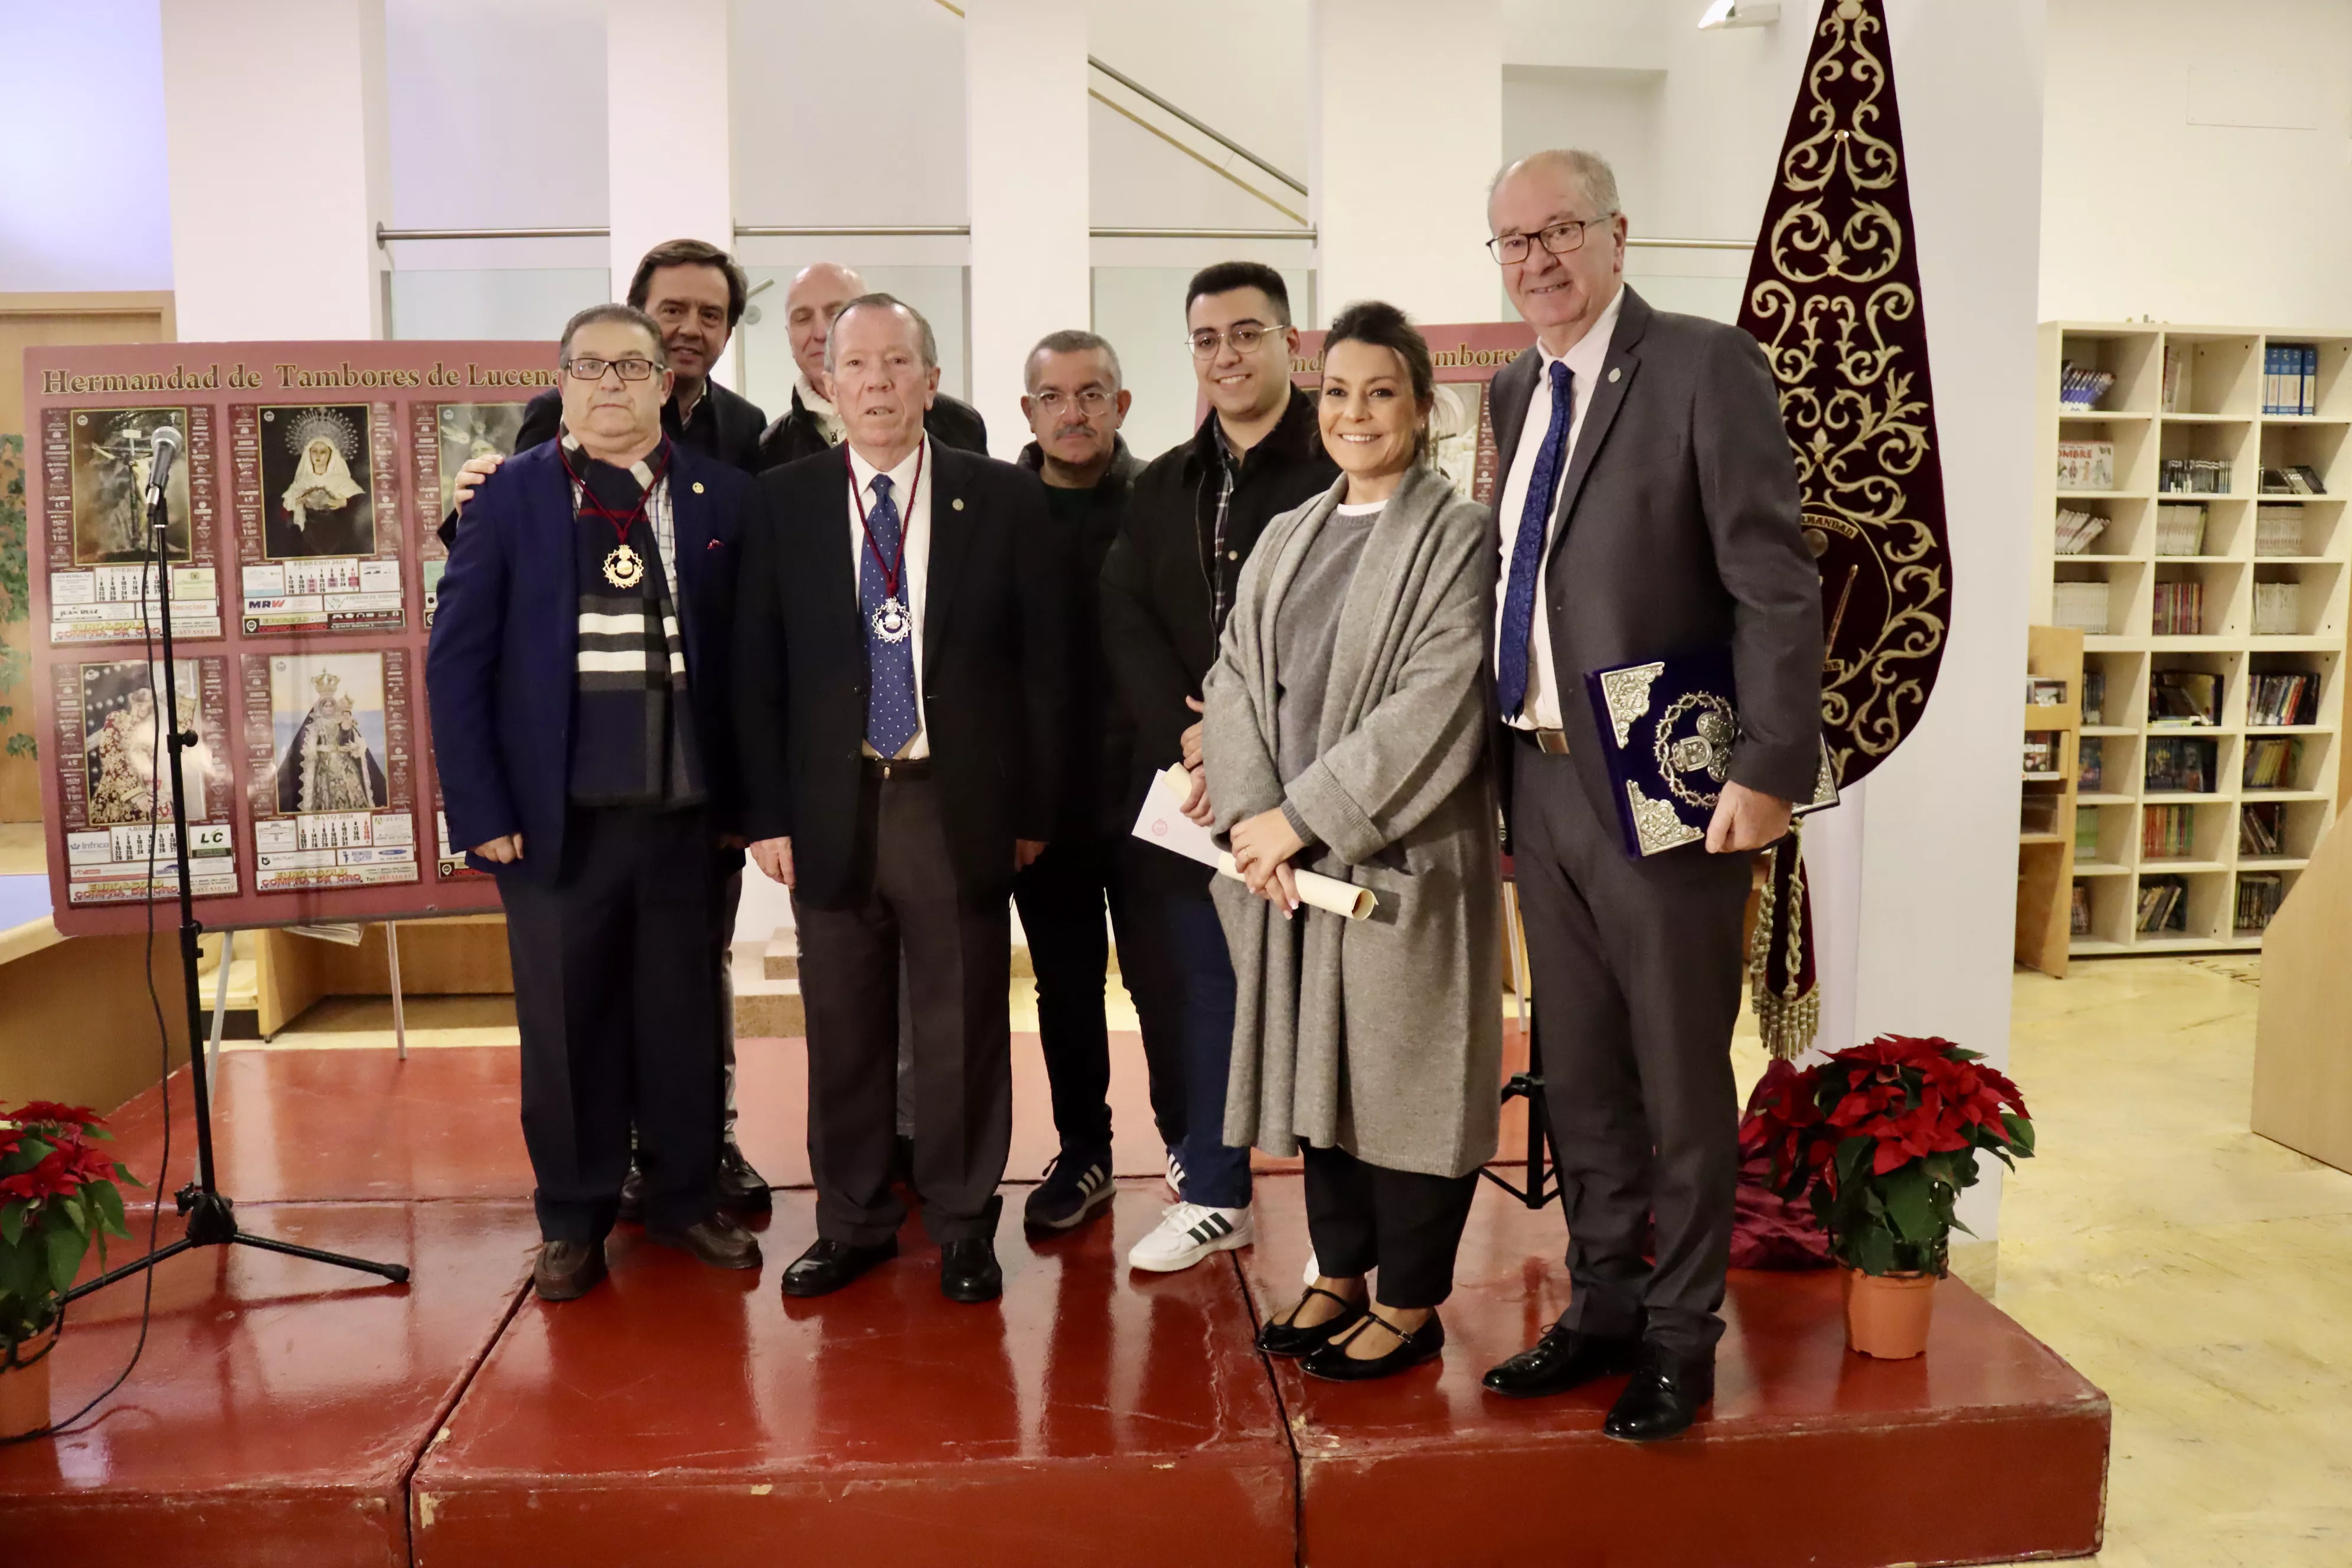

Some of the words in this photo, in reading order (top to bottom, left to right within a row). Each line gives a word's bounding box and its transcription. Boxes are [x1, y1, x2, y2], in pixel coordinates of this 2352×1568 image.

[1433, 342, 1523, 368] mbore
[41, 364, 222, 394] Hermandad
[227, 362, 263, 388] de
[275, 362, 422, 389] Tambores
[426, 361, 460, 387] de
[249, 599, 285, 609] MRW
[82, 841, 109, 850] Infrico
[89, 879, 164, 891] EURO&GOD
